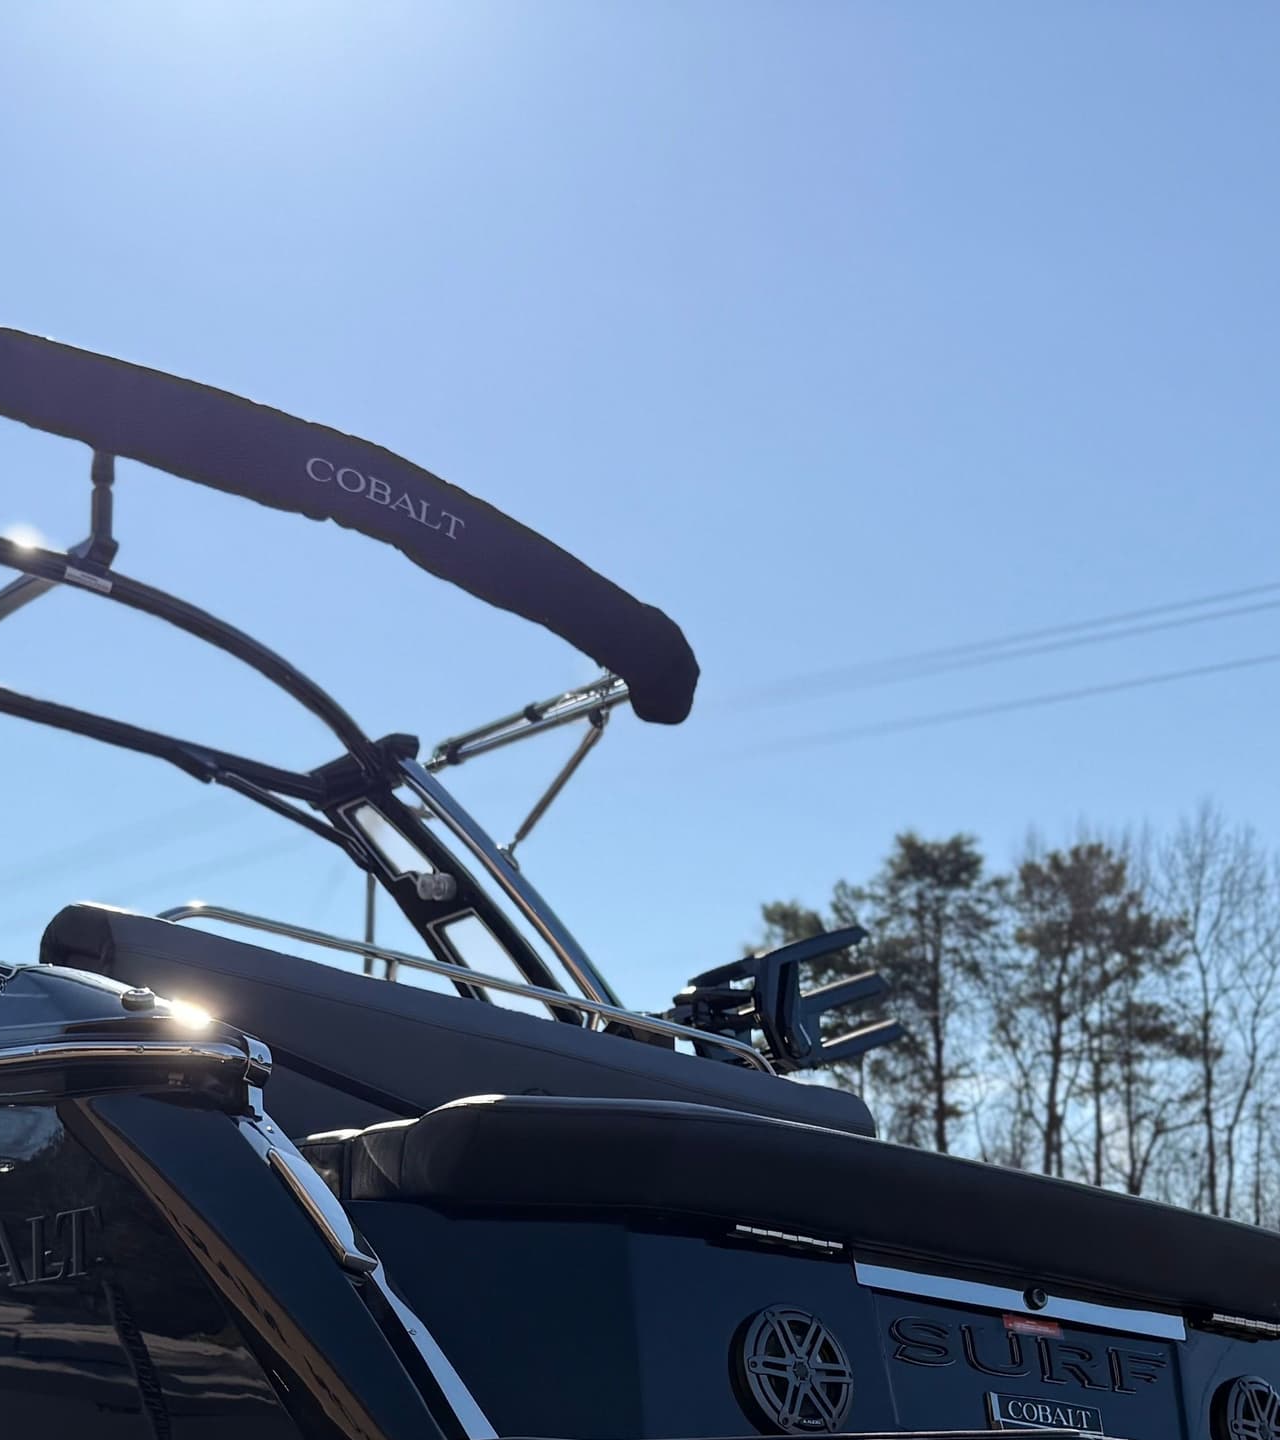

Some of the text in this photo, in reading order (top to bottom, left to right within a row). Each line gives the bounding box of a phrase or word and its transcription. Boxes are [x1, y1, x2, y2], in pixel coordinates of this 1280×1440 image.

[305, 457, 465, 540] COBALT
[888, 1315, 1167, 1395] SURF
[1008, 1400, 1091, 1428] COBALT
